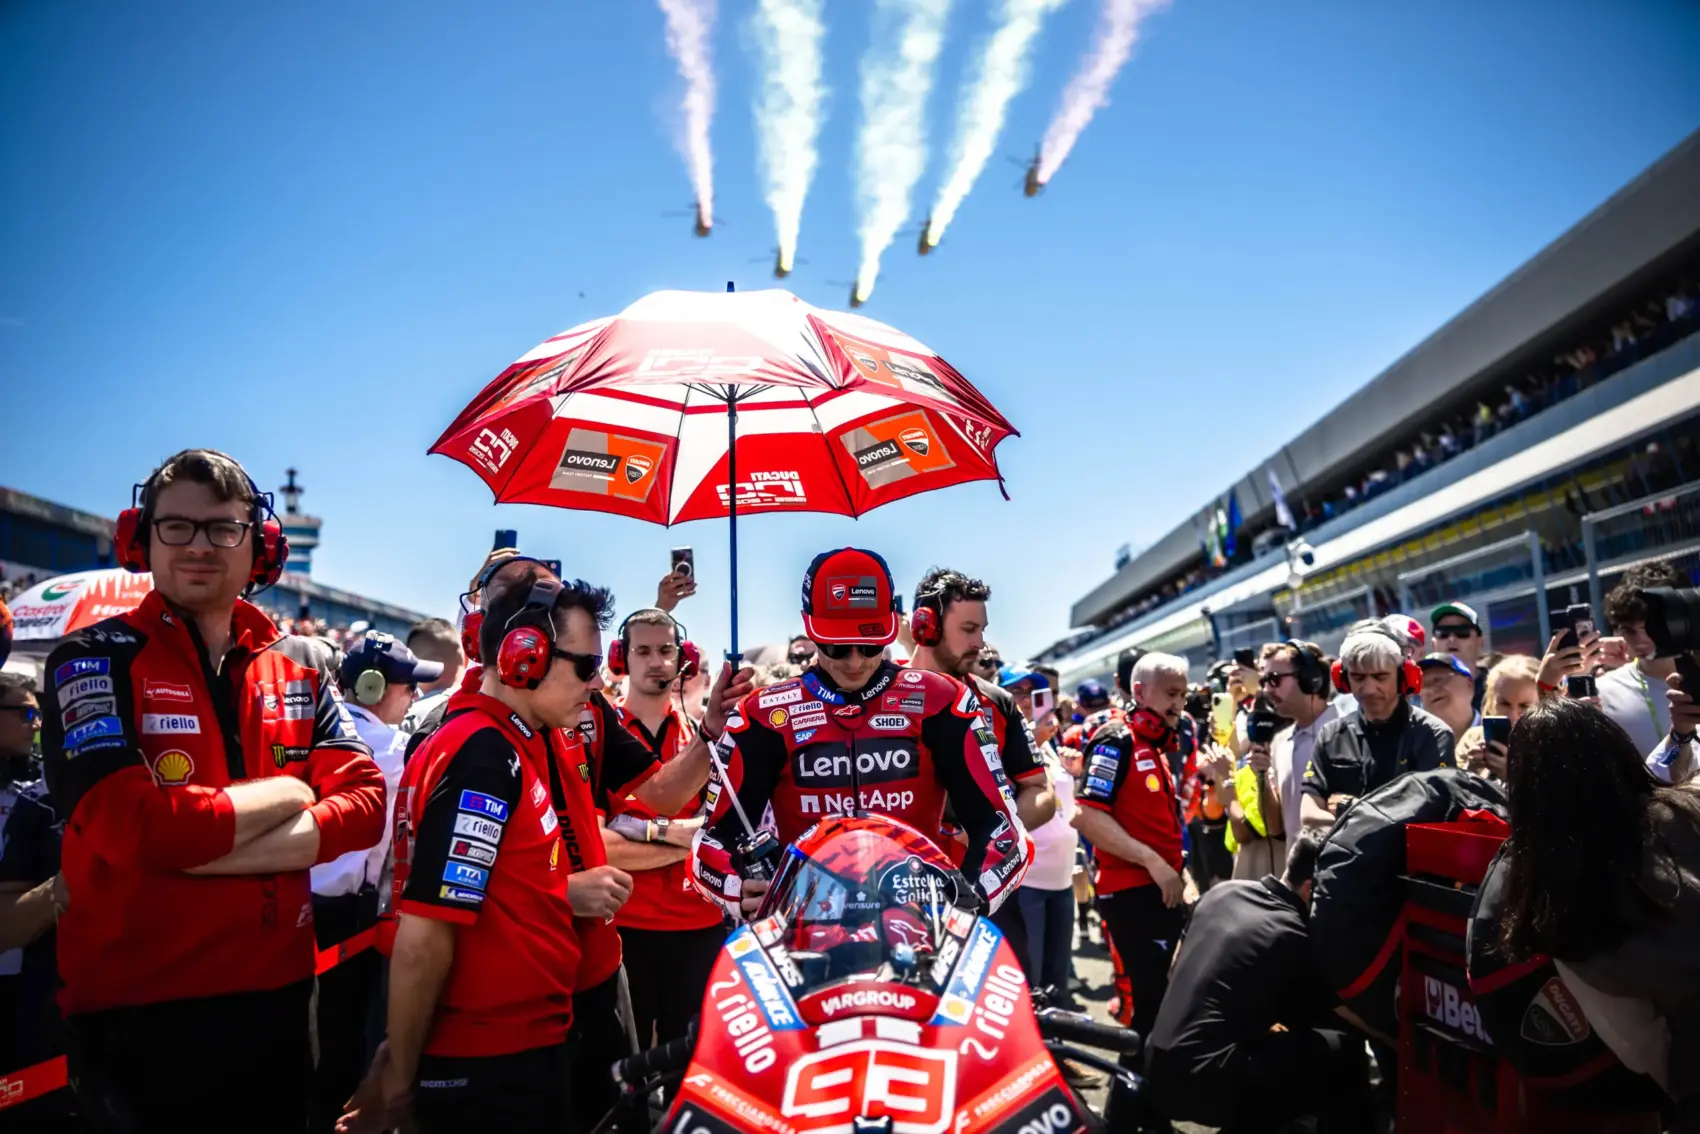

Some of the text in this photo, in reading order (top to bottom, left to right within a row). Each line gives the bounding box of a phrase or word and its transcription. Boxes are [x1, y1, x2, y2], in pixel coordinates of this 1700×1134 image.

[73, 661, 100, 671] TIM
[69, 679, 108, 696] riello
[817, 686, 835, 702] TIM
[861, 676, 889, 700] Lenovo
[763, 692, 798, 705] EATALY
[798, 702, 822, 712] riello
[160, 717, 195, 729] riello
[510, 714, 531, 738] Lenovo
[793, 715, 825, 726] CARRERA
[875, 718, 905, 726] SHOEI
[795, 732, 812, 741] SAP
[799, 749, 911, 777] Lenovo
[485, 799, 504, 816] TIM
[824, 789, 914, 812] NetApp
[472, 820, 499, 839] riello
[557, 815, 586, 873] DUCAT
[456, 866, 481, 880] ITA
[996, 853, 1020, 879] Lenovo
[700, 865, 722, 888] Lenovo
[895, 889, 943, 905] Galica
[975, 964, 1026, 1040] riello
[1550, 984, 1583, 1034] DUCATI
[716, 993, 776, 1073] riello
[1018, 1103, 1071, 1134] ovo
